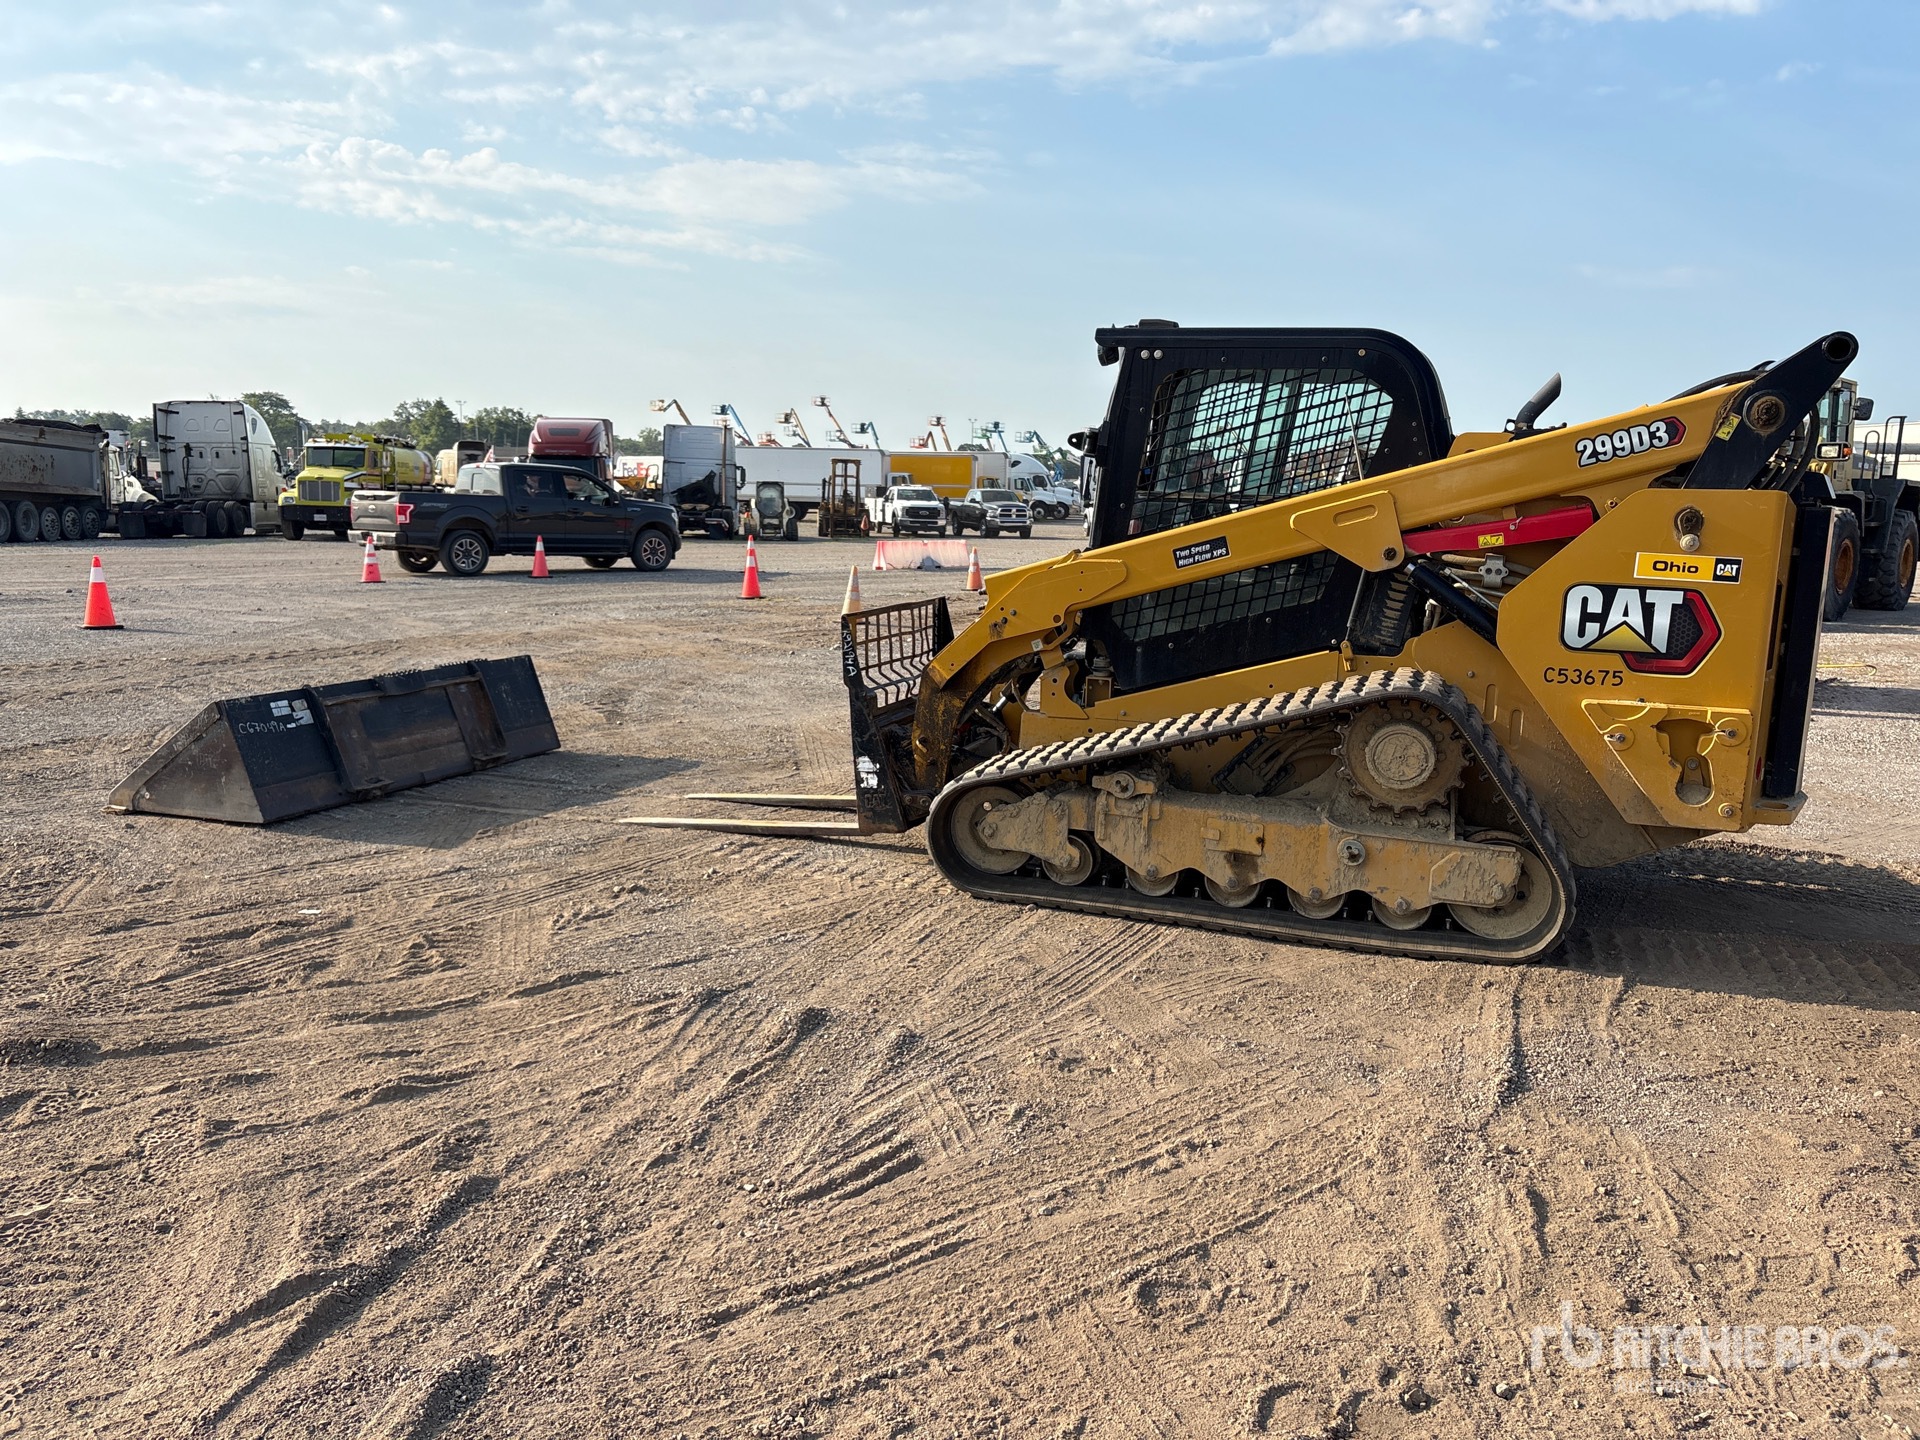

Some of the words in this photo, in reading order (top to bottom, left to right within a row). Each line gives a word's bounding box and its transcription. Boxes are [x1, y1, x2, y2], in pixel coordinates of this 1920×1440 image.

[1576, 421, 1670, 467] 299D3
[1212, 547, 1227, 558] XPS
[1652, 560, 1699, 574] Ohio
[1716, 563, 1739, 577] CAT
[1563, 585, 1684, 654] CAT
[1543, 666, 1624, 687] C53675
